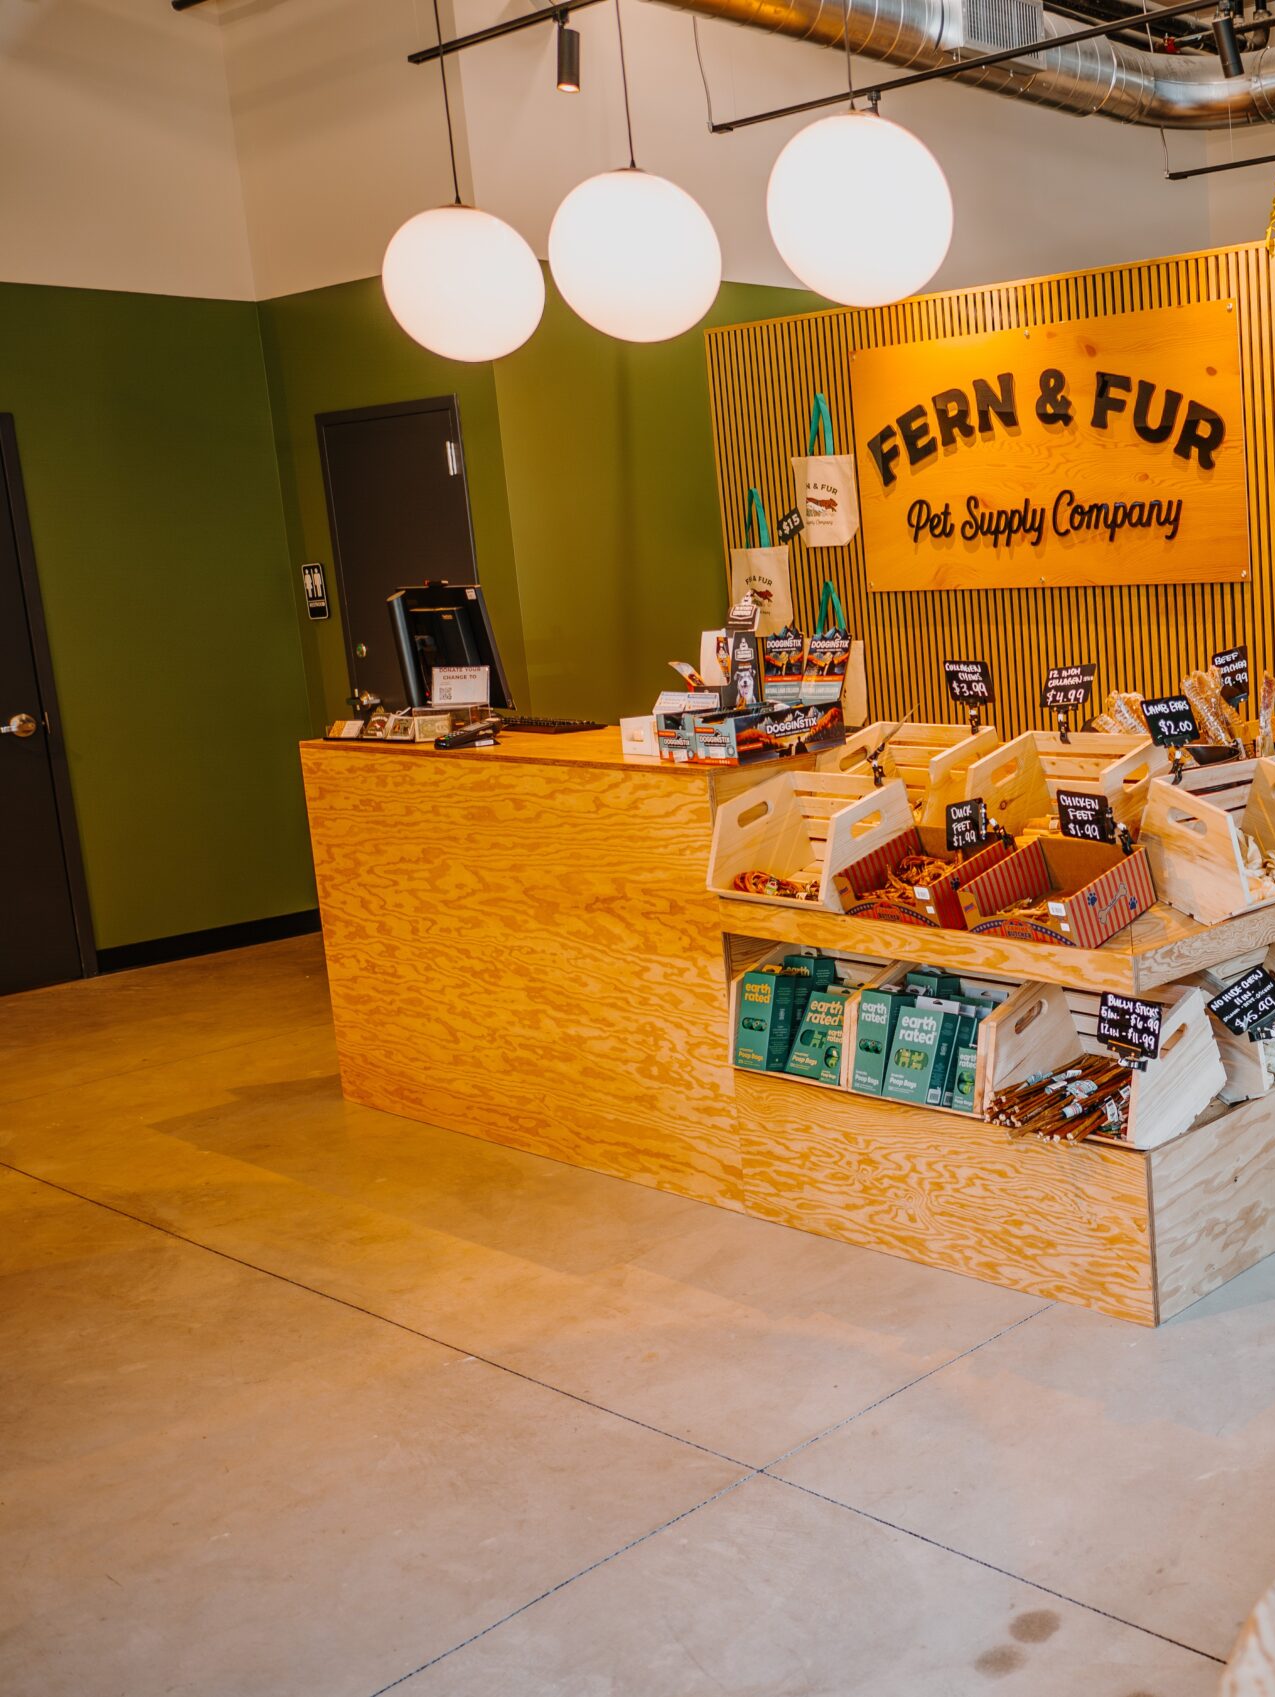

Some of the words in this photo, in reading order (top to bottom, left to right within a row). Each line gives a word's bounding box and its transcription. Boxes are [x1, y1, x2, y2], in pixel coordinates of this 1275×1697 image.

[867, 372, 1018, 486] FERN
[1035, 368, 1074, 424] &
[1091, 371, 1227, 470] FUR
[821, 483, 838, 495] FUR
[783, 513, 800, 535] $15
[907, 499, 954, 542] Pet
[961, 495, 1046, 547] Supply
[1052, 489, 1183, 541] Company
[758, 575, 773, 587] FUR
[766, 637, 802, 649] DOGGINSTIX
[811, 637, 850, 649] DOGGINSTIX
[1214, 651, 1238, 666] BEEF
[945, 663, 982, 673] COLLAGEN
[1049, 670, 1058, 679] 12
[1061, 667, 1081, 677] INCH
[1048, 675, 1083, 688] COLLAGEN
[952, 682, 988, 697] $3.99
[1047, 688, 1085, 705] $4.99
[1143, 702, 1169, 716] LAMB
[1169, 699, 1189, 712] EARS
[766, 716, 817, 736] DOGGINSTIX
[1158, 719, 1193, 736] $2.00
[699, 735, 730, 744] DOGGINSTIX
[1059, 794, 1100, 810] CHICKEN
[950, 804, 973, 820] DUCK
[1067, 810, 1096, 821] FEET
[952, 820, 971, 835] FEET
[1068, 823, 1100, 839] $1.99
[952, 831, 977, 847] $1.99
[1008, 931, 1032, 940] BUTCHER
[745, 982, 771, 994] earth
[1210, 1000, 1224, 1011] NO
[1222, 985, 1242, 1002] HIDE
[1241, 969, 1264, 989] CHEW
[744, 991, 770, 1004] rated
[810, 1000, 843, 1014] earth
[862, 1001, 887, 1014] earth
[1107, 994, 1134, 1013] BULLY
[1135, 1001, 1160, 1018] STICKS
[806, 1012, 840, 1026] rated
[861, 1012, 887, 1025] rated
[901, 1015, 937, 1032] earth
[1130, 1014, 1160, 1034] $6.99
[899, 1028, 936, 1045] rated
[1100, 1022, 1120, 1038] 12IN
[1127, 1027, 1155, 1050] $11.99
[738, 1051, 752, 1059] Poop
[751, 1053, 764, 1062] Bags
[792, 1055, 804, 1063] Poop
[804, 1057, 818, 1065] Bags
[854, 1074, 867, 1082] Poop
[867, 1077, 879, 1086] Bags
[889, 1076, 903, 1085] Poop
[903, 1079, 917, 1089] Bags
